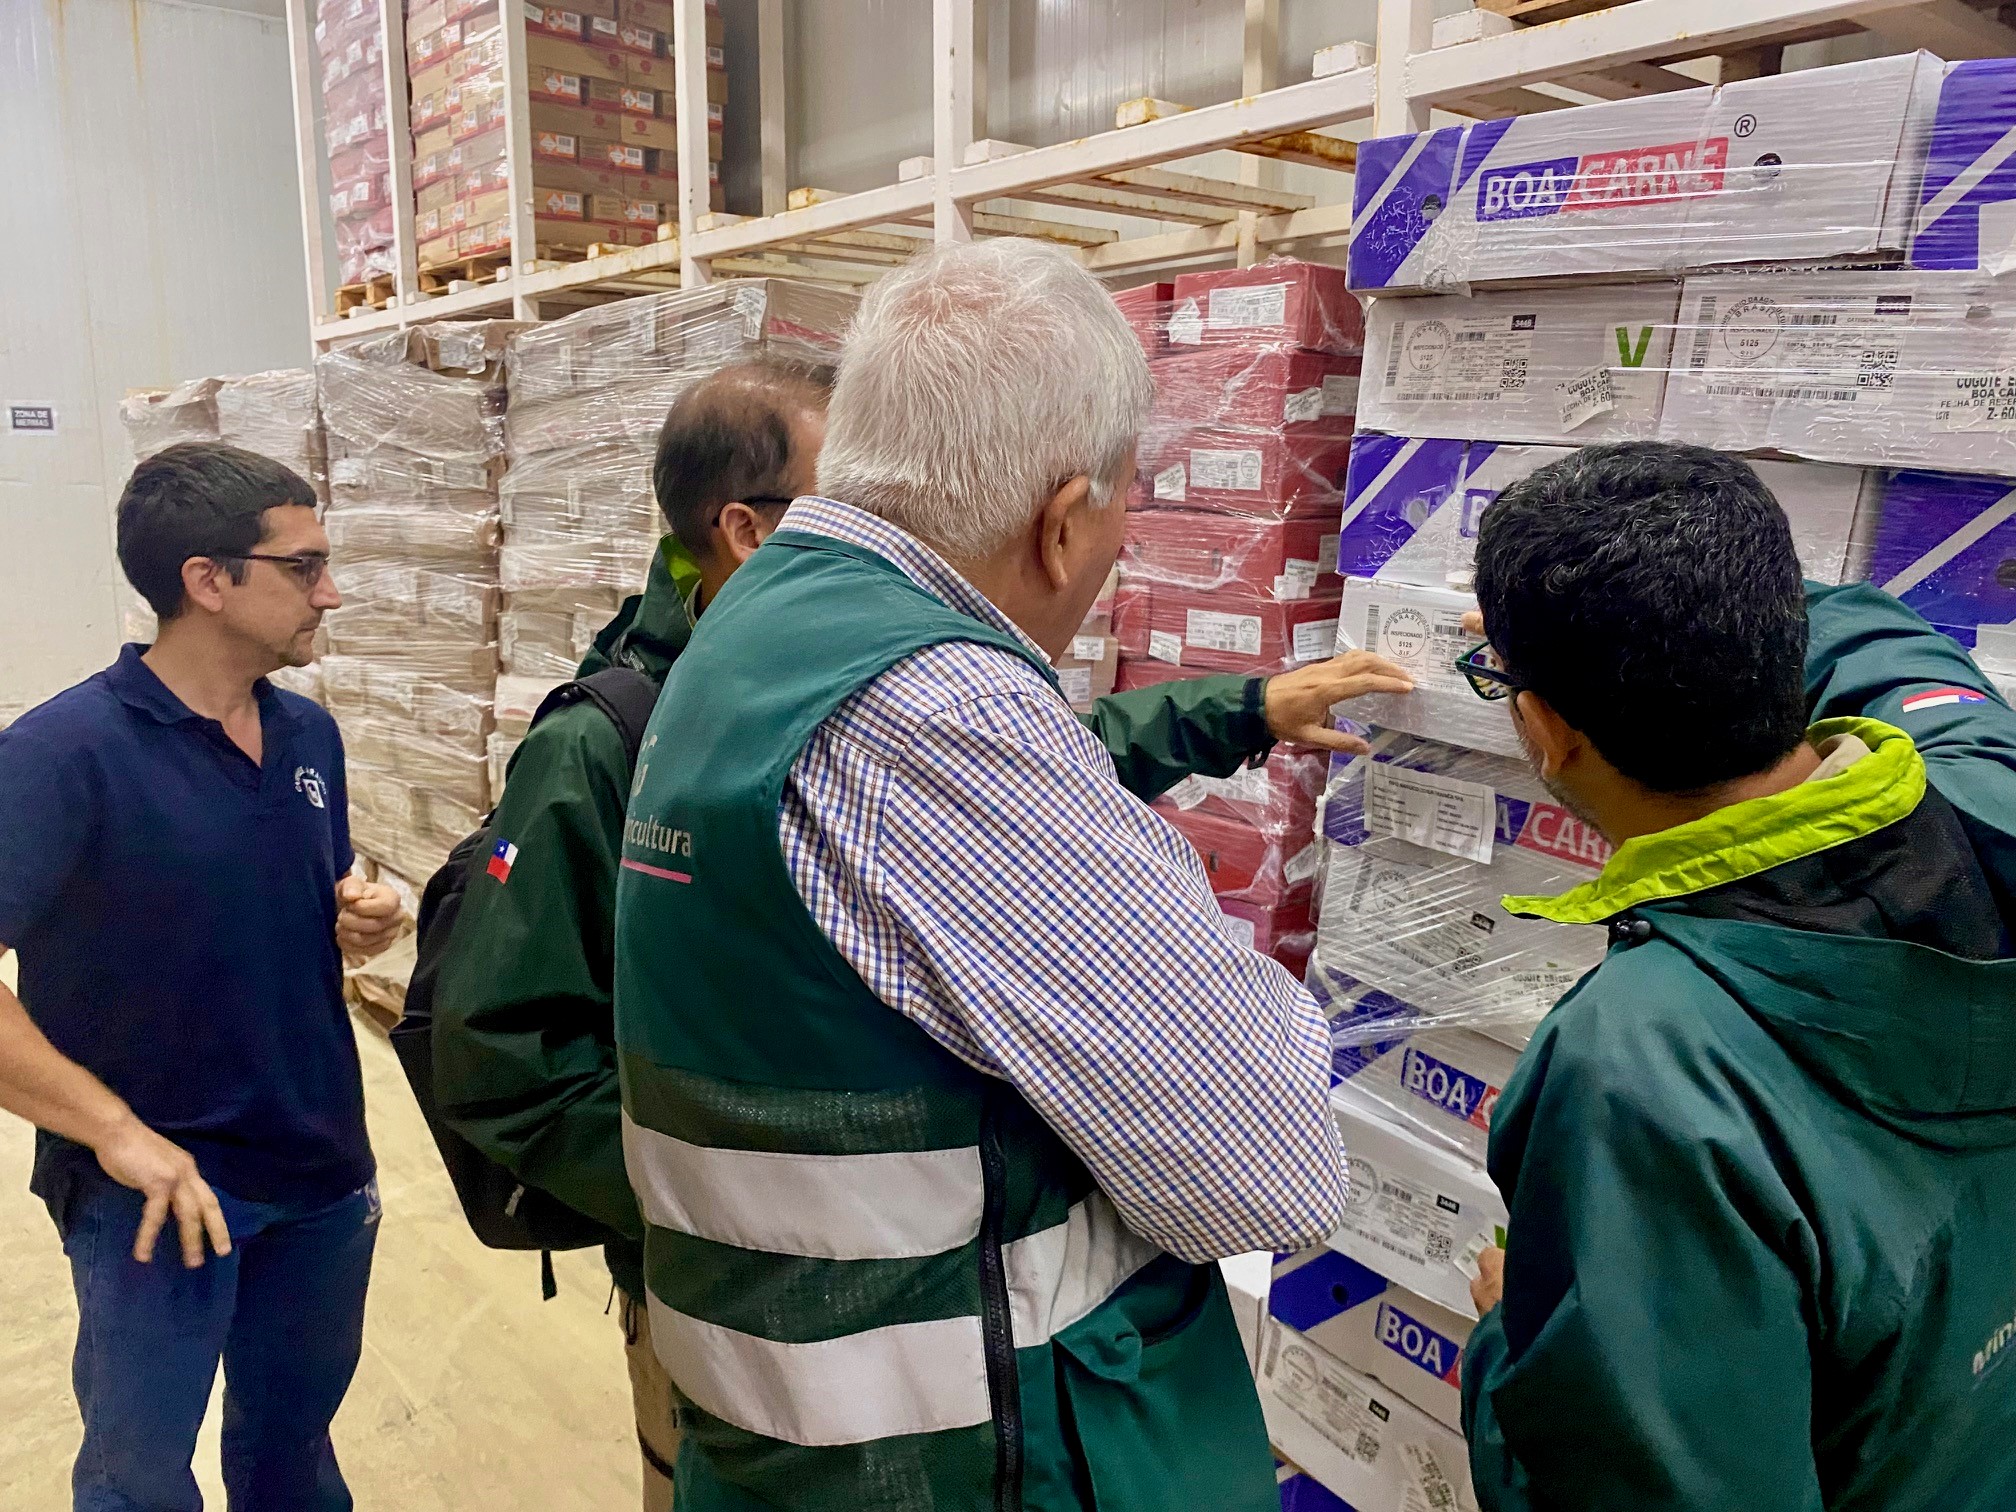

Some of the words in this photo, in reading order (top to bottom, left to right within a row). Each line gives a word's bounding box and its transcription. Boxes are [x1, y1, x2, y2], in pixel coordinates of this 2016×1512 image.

[1484, 167, 1558, 215] BOA
[1574, 149, 1718, 203] CARNE
[1615, 326, 1654, 368] V
[1972, 389, 1995, 399] BOA
[1393, 613, 1421, 626] BRASIL
[1405, 1055, 1468, 1116] BOA
[1382, 1309, 1442, 1374] BOA
